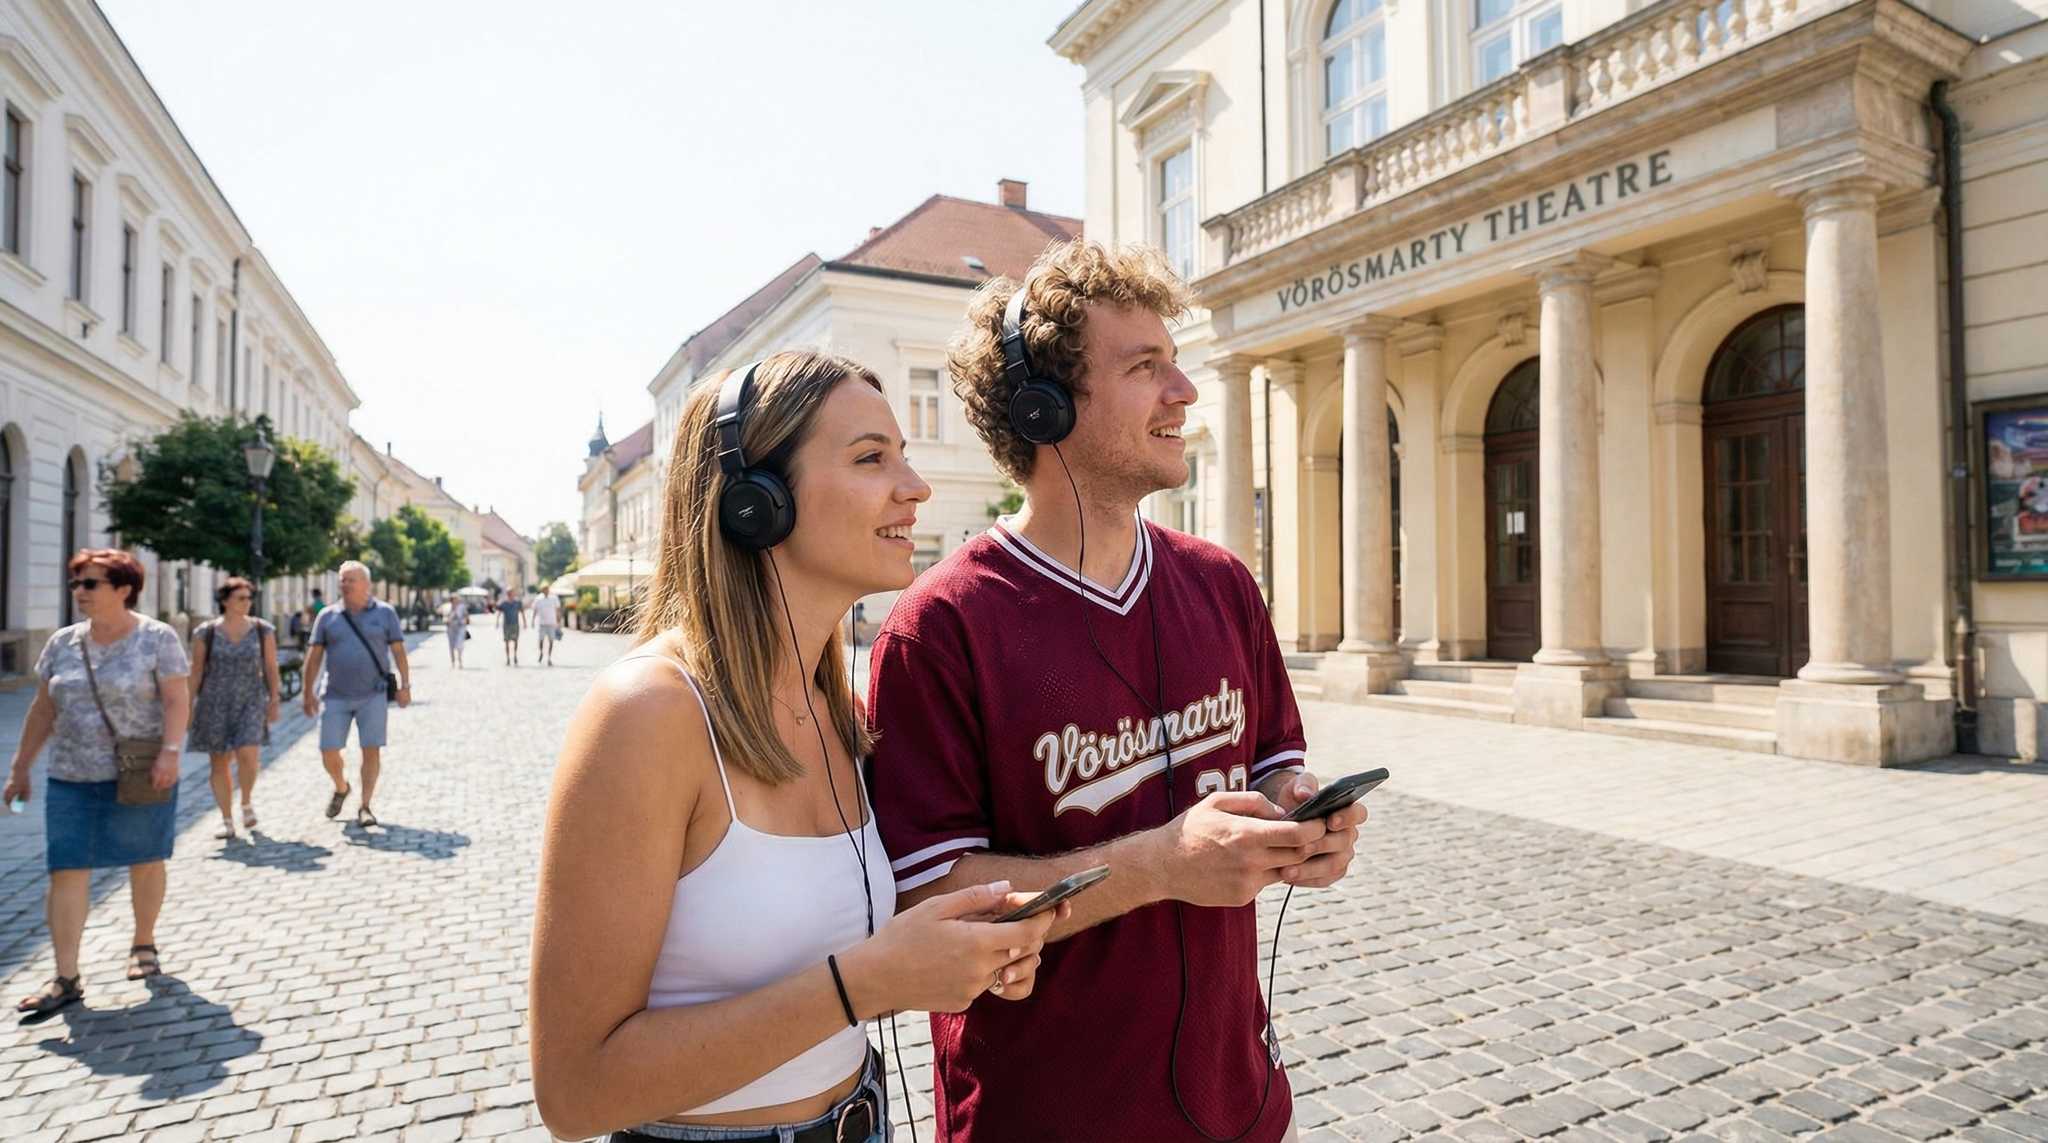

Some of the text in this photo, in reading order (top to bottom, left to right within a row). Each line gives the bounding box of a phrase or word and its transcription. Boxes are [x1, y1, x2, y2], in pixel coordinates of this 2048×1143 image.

[1277, 150, 1673, 312] VÖRÖSMARTY THEATRE
[1034, 678, 1246, 793] Vörösmarty
